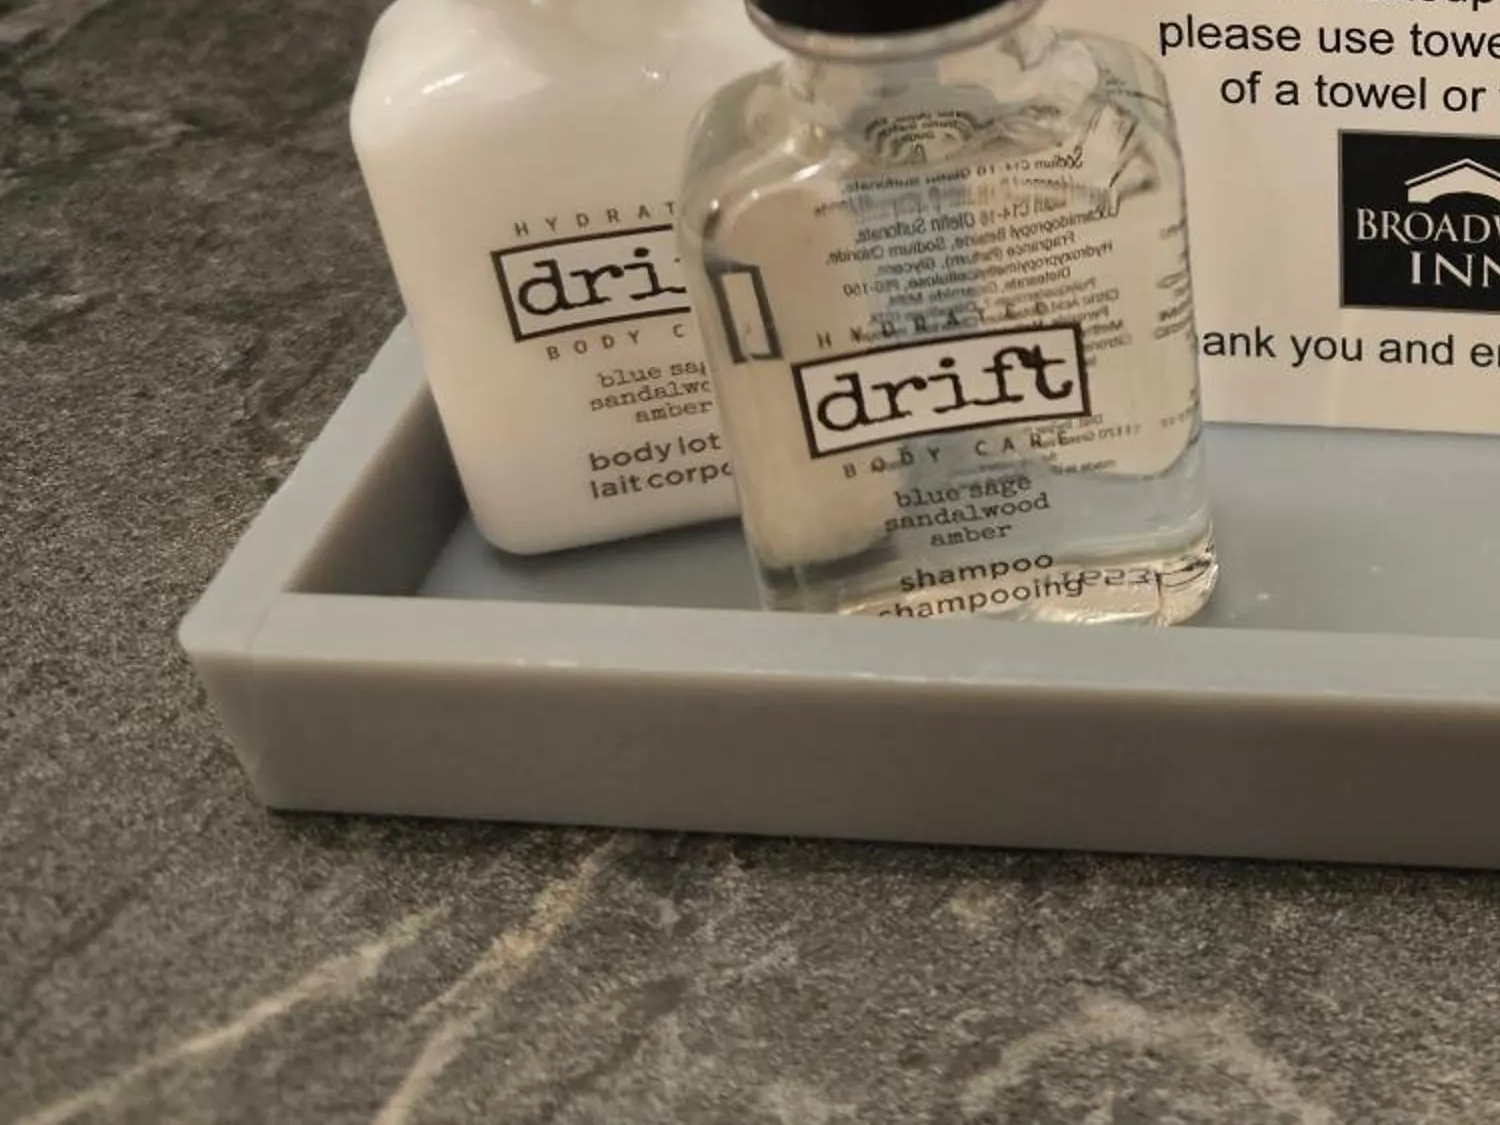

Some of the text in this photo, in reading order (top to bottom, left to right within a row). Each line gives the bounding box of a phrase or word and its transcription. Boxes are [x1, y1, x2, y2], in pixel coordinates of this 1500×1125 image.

[1159, 14, 1301, 55] please
[1319, 28, 1394, 55] use
[1220, 70, 1260, 105] of
[1276, 79, 1299, 106] a
[1315, 74, 1427, 111] towel
[1443, 83, 1485, 113] or
[514, 201, 675, 237] HYDRAT
[517, 246, 686, 315] dri
[546, 330, 641, 360] BODY
[1203, 325, 1276, 357] ank
[1291, 333, 1362, 368] you
[1378, 333, 1455, 366] and
[590, 379, 711, 412] sandalwo
[597, 365, 663, 388] blue
[817, 344, 1074, 431] drift
[635, 398, 713, 424] amber
[589, 432, 721, 472] body lot
[843, 445, 941, 478] BODY
[975, 431, 1071, 456] CARE
[590, 477, 642, 500] lait
[894, 475, 1033, 507] blue sage
[884, 492, 1050, 533] sandalwood
[930, 524, 1013, 547] amber
[900, 554, 1054, 592] shampoo
[880, 573, 1084, 618] hampooing
